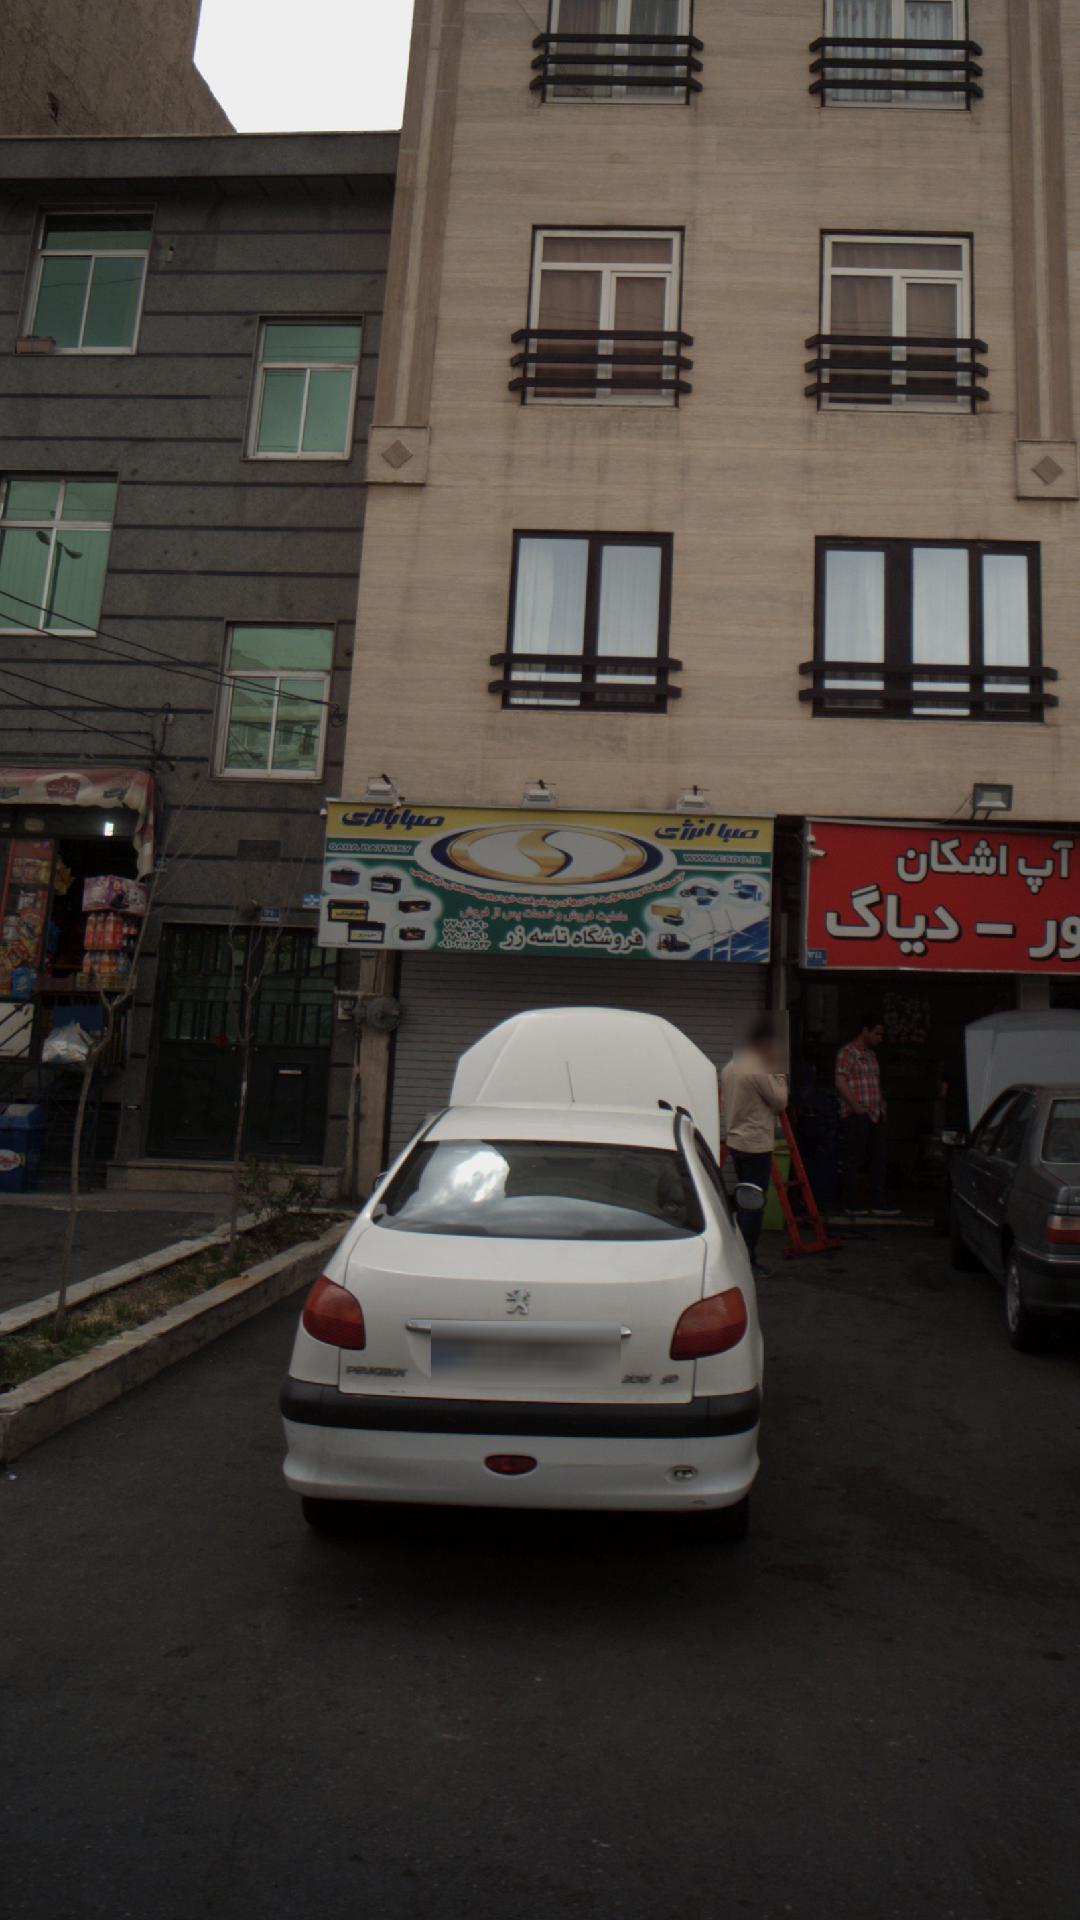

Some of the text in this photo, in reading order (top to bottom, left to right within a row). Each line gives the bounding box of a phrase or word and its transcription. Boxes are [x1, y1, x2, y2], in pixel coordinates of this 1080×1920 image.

[654, 818, 760, 843] صبا انرژی
[896, 837, 1075, 894] آپ اشکان
[572, 925, 646, 952] فروشگاه
[825, 884, 962, 956] دیاگ
